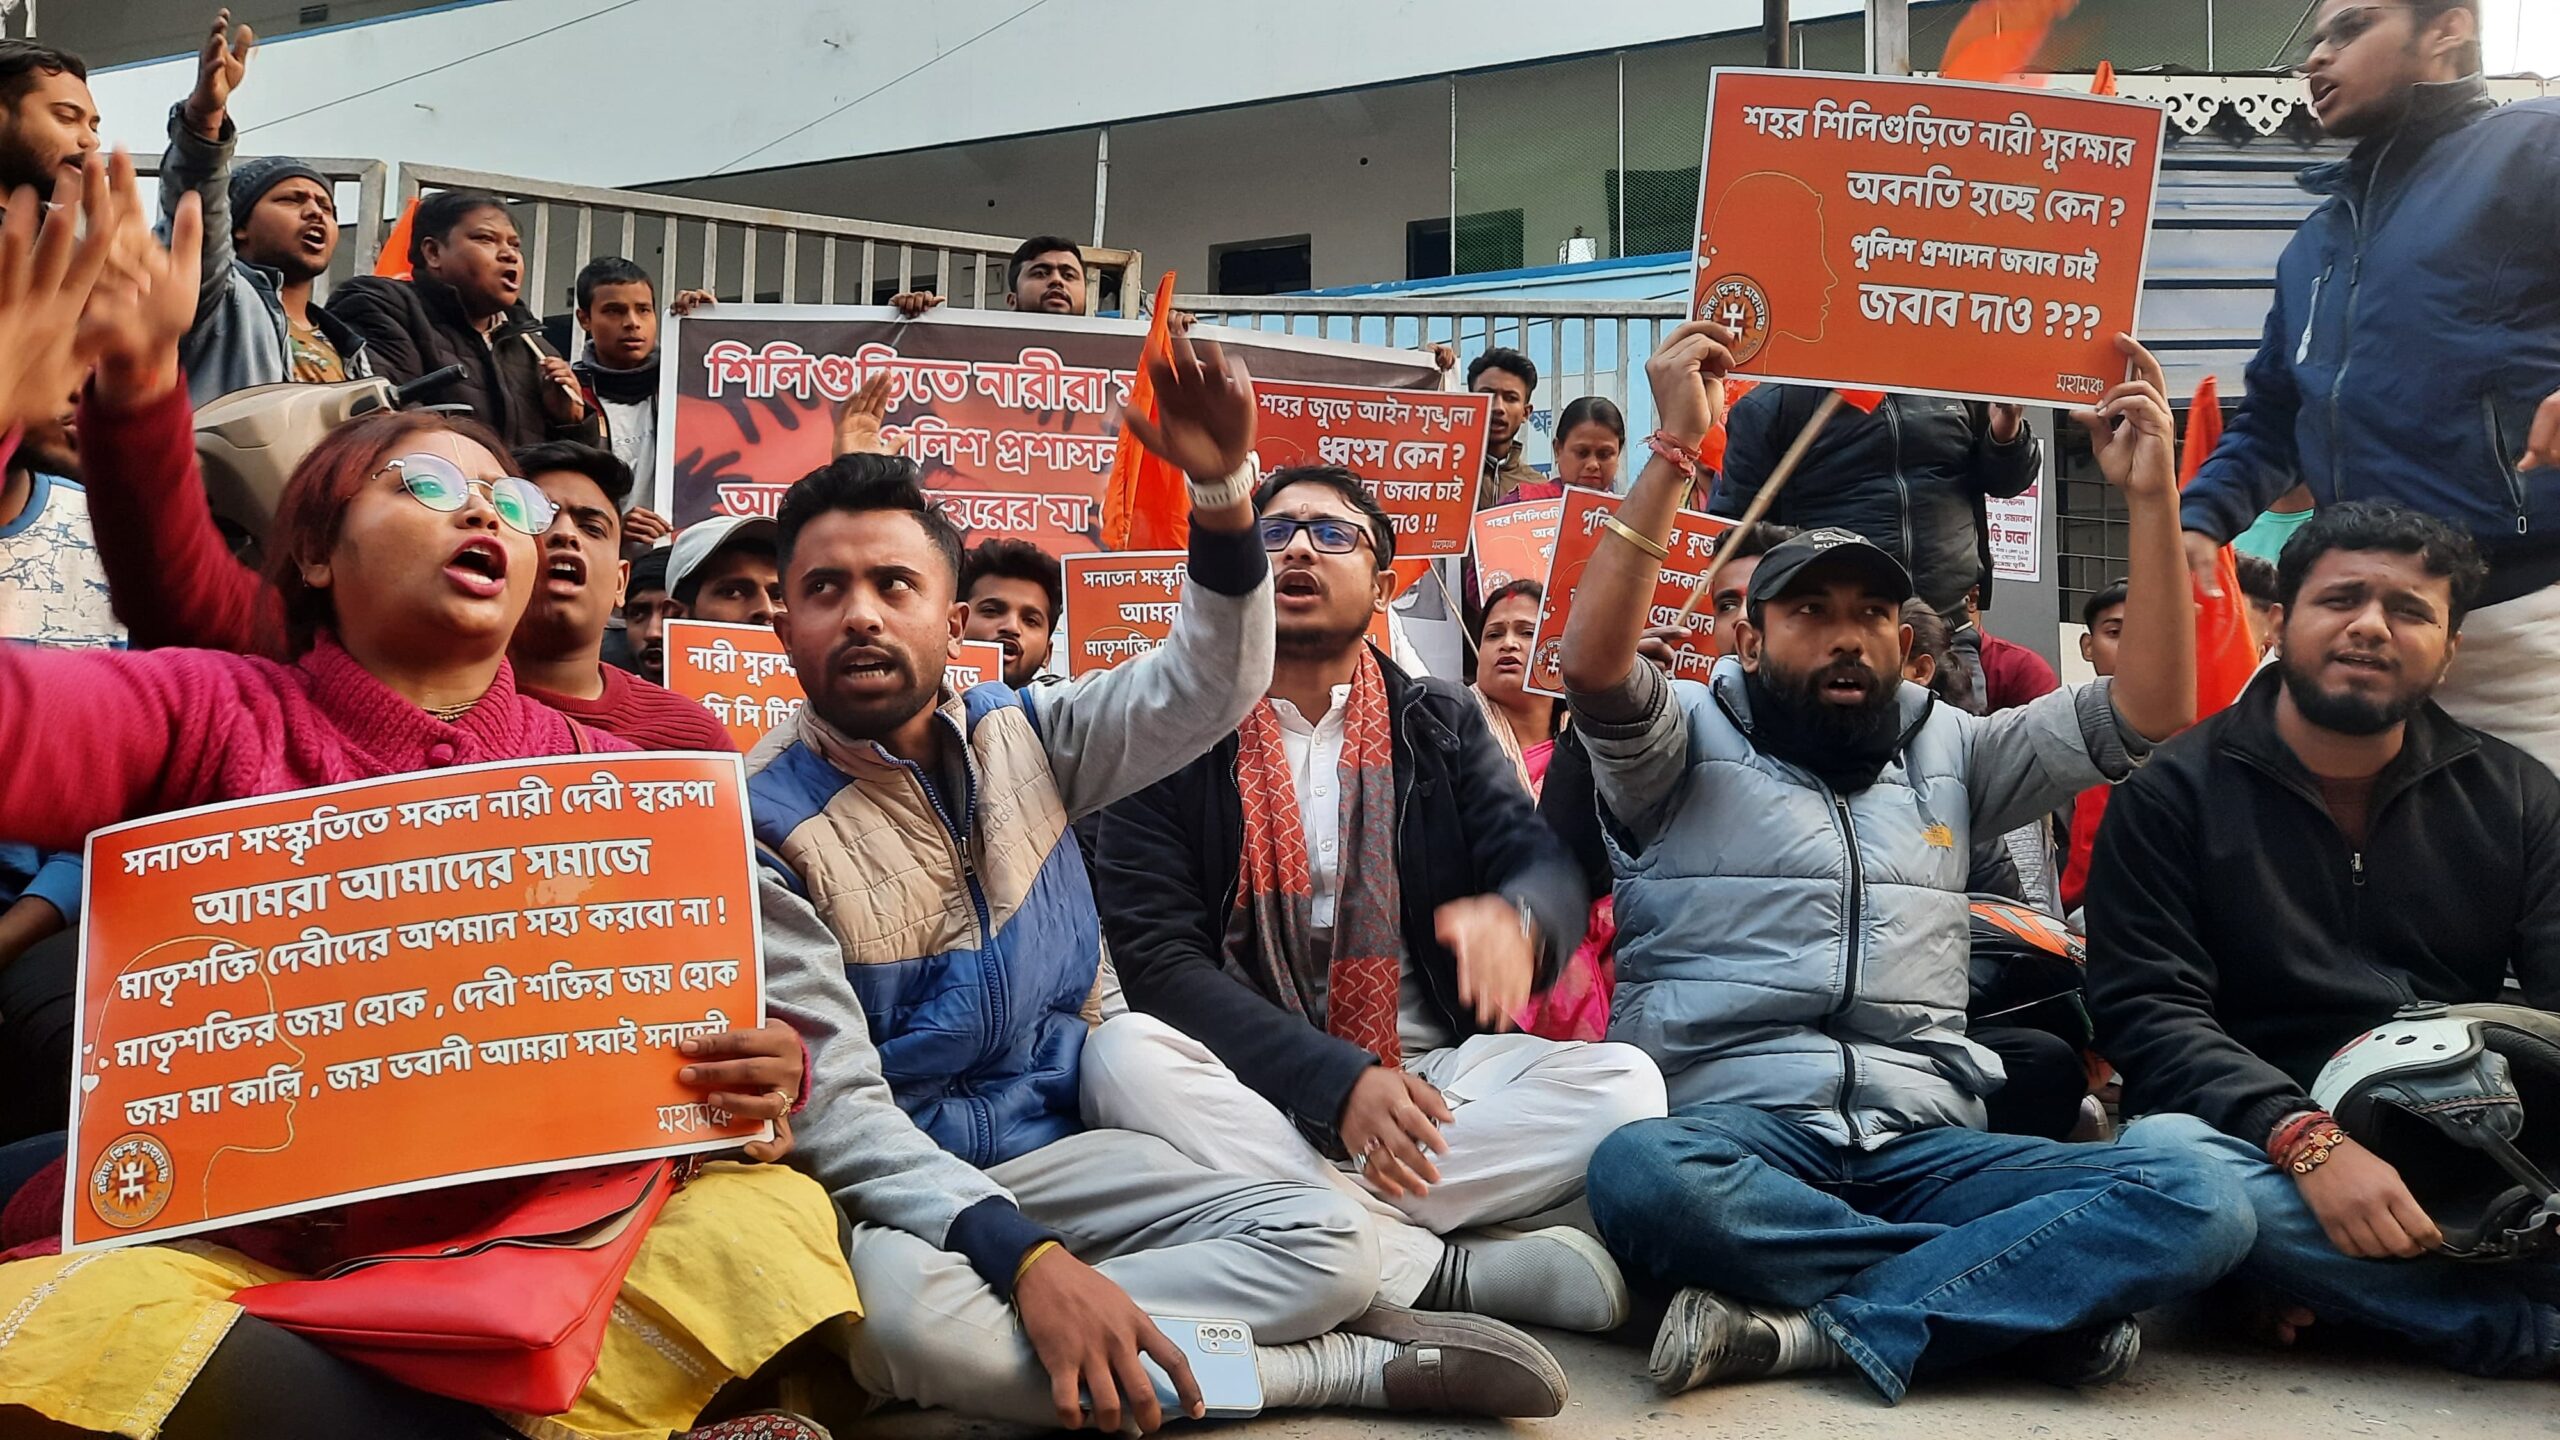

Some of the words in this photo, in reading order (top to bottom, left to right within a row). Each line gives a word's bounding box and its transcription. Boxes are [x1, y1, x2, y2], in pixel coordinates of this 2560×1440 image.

[1743, 105, 1808, 141] শহর
[1813, 100, 1974, 153] শিলিগুড়িতে
[1978, 112, 2036, 156] নারী
[2041, 129, 2136, 173] সুরক্ষার
[1846, 166, 1965, 210] অবনতি
[1970, 182, 2041, 223] হচ্ছে
[2044, 191, 2103, 226] কেন
[2110, 198, 2125, 227] ?
[1851, 229, 1916, 270] পুলিশ
[1920, 240, 1996, 270] প্রশাসন
[2000, 248, 2060, 277] জবাব
[2063, 248, 2099, 283] চাই
[1858, 283, 1961, 328] জবাব
[1970, 293, 2032, 335] দাও
[2044, 302, 2101, 340] ???
[976, 347, 1110, 413] নারীরা
[2055, 373, 2104, 395] মহামঞ্চ
[1260, 393, 1303, 419] শহর
[1308, 397, 1353, 429] জুড়ে
[1357, 396, 1412, 426] আইন
[1318, 436, 1388, 468] ধ্বংস
[1394, 442, 1448, 470] কেন
[1452, 444, 1466, 470] ?
[1046, 496, 1092, 533] মা
[1383, 480, 1433, 502] জবাব
[1436, 476, 1464, 502] চাই
[1425, 514, 1437, 533] !!
[1082, 569, 1136, 589] সনাতন
[686, 639, 739, 674] নারী
[734, 695, 762, 728] সি
[122, 838, 230, 879] সনাতন
[240, 803, 391, 865] সংস্কৃতিতে
[398, 794, 480, 829] সকল
[488, 774, 552, 820] নারী
[561, 770, 624, 815] দেবী
[629, 779, 716, 815] স্বরূপা
[192, 872, 331, 928] আমরা
[338, 845, 515, 903] আমাদের
[522, 836, 653, 881] সমাজে
[118, 941, 262, 1006] মাতৃশক্তি
[268, 922, 391, 981] দেবীদের
[398, 911, 518, 952] অপমান
[524, 904, 582, 940] সহ্য
[588, 900, 675, 936] করবো
[679, 898, 716, 928] না
[115, 1012, 278, 1071] মাতৃশক্তির
[286, 1009, 346, 1041] জয়
[354, 991, 428, 1028] হোক
[452, 972, 517, 1014] দেবী
[523, 965, 614, 1002] শক্তির
[621, 962, 673, 996] জয়
[679, 960, 739, 992] হোক
[125, 1094, 181, 1129] জয়
[189, 1086, 224, 1116] মা
[230, 1068, 303, 1106] কালি
[326, 1059, 381, 1094] জয়
[389, 1036, 473, 1081] ভবানী
[480, 1035, 568, 1066] আমরা
[573, 1018, 639, 1056] সবাই
